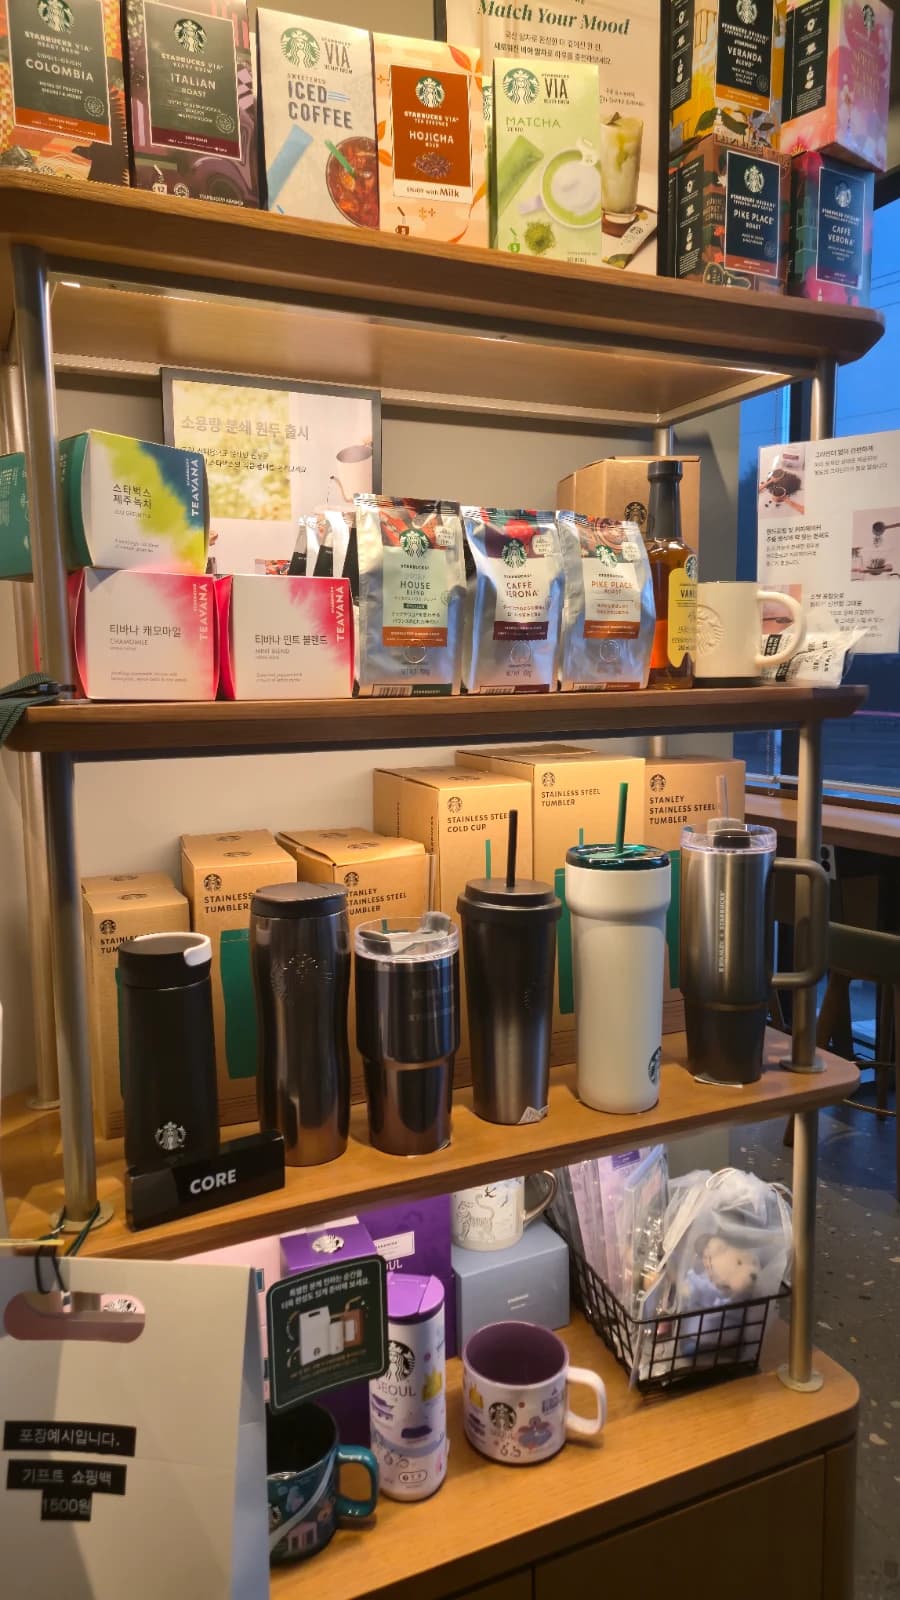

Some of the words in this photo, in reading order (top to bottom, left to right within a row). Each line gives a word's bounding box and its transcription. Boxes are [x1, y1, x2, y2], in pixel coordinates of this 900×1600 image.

[477, 1, 532, 22] Match
[537, 8, 577, 28] Your
[581, 14, 631, 35] Mood
[24, 31, 72, 48] STARBUCKS
[161, 53, 205, 67] STARBUCKS
[325, 42, 351, 69] VIA
[727, 45, 762, 63] VERANDA
[25, 58, 94, 83] COLOMBIA
[171, 73, 216, 90] ITALIAN
[545, 78, 569, 99] VIA
[181, 88, 206, 97] ROAST
[288, 80, 327, 103] ICED
[288, 102, 353, 129] COFFEE
[404, 111, 443, 122] STARBUCKS
[505, 116, 561, 129] MATCHA
[409, 130, 454, 144] HOJICHA
[440, 187, 460, 198] Milk
[733, 209, 750, 220] PIKE
[751, 213, 773, 225] PLACE
[828, 234, 854, 246] VERONA
[181, 414, 220, 433] 소용량
[225, 418, 252, 436] 분쇄
[255, 421, 281, 439] 원두
[284, 424, 310, 441] 출시
[112, 484, 152, 499] 스타벅스
[191, 459, 199, 517] TEAVANA
[400, 580, 431, 591] HOUSE
[591, 580, 609, 588] PIKE
[610, 581, 633, 589] PLACE
[199, 583, 208, 641] TEAVANA
[336, 586, 345, 641] TEAVANA
[109, 624, 139, 634] 티바나
[143, 624, 182, 638] 캐모마일
[255, 634, 280, 646] 티바나
[283, 634, 301, 646] 민트
[302, 635, 328, 646] 블렌드
[541, 789, 579, 799] STAINLESS
[580, 788, 601, 796] STEEL
[649, 795, 685, 805] STANLEY
[541, 798, 576, 808] TUMBLER
[649, 804, 692, 815] STAINLESS
[693, 803, 716, 812] STEEL
[447, 814, 488, 824] STAINLESS
[490, 812, 510, 821] STEE
[649, 815, 688, 826] TUMBLER
[447, 825, 469, 833] COLD
[470, 823, 487, 831] CUP
[203, 892, 254, 904] STAINLESS
[347, 896, 385, 907] TAINLESS
[386, 892, 407, 902] STEEL
[204, 903, 250, 914] TUMBLER
[349, 905, 381, 916] UMBLER
[190, 1169, 237, 1195] CORE
[376, 1382, 417, 1397] SEOUL
[19, 1427, 120, 1447] 포장예시입니다.
[23, 1468, 64, 1484] 기프트
[71, 1469, 112, 1487] 쇼핑백
[42, 1497, 93, 1516] 1500원
